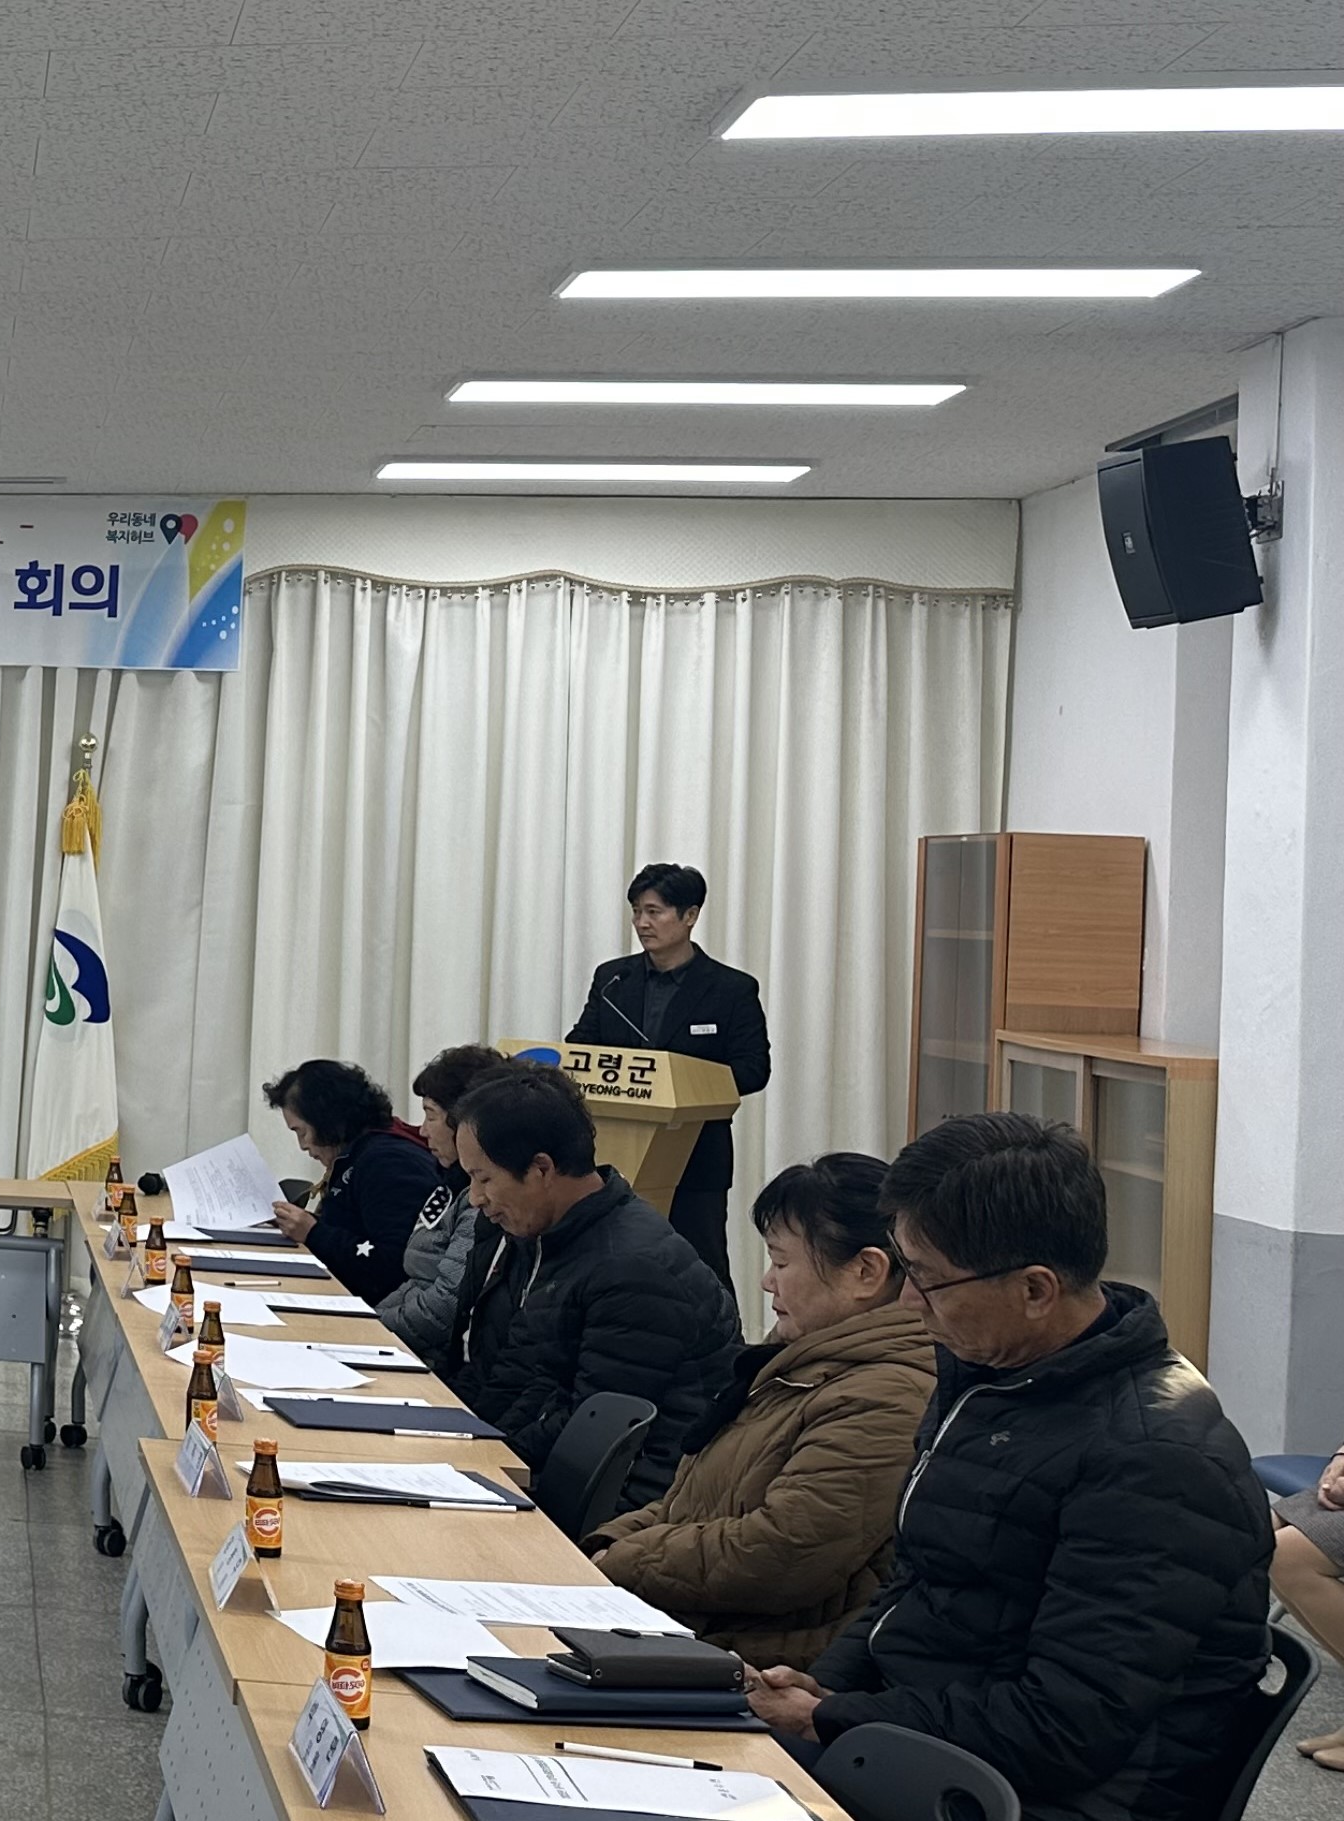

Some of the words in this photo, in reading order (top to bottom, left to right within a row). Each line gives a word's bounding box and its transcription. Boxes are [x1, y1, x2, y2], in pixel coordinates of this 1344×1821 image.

[106, 511, 157, 527] 우리동네
[105, 529, 155, 544] 복지허브
[13, 559, 120, 619] 회의
[564, 1050, 657, 1086] 고령군
